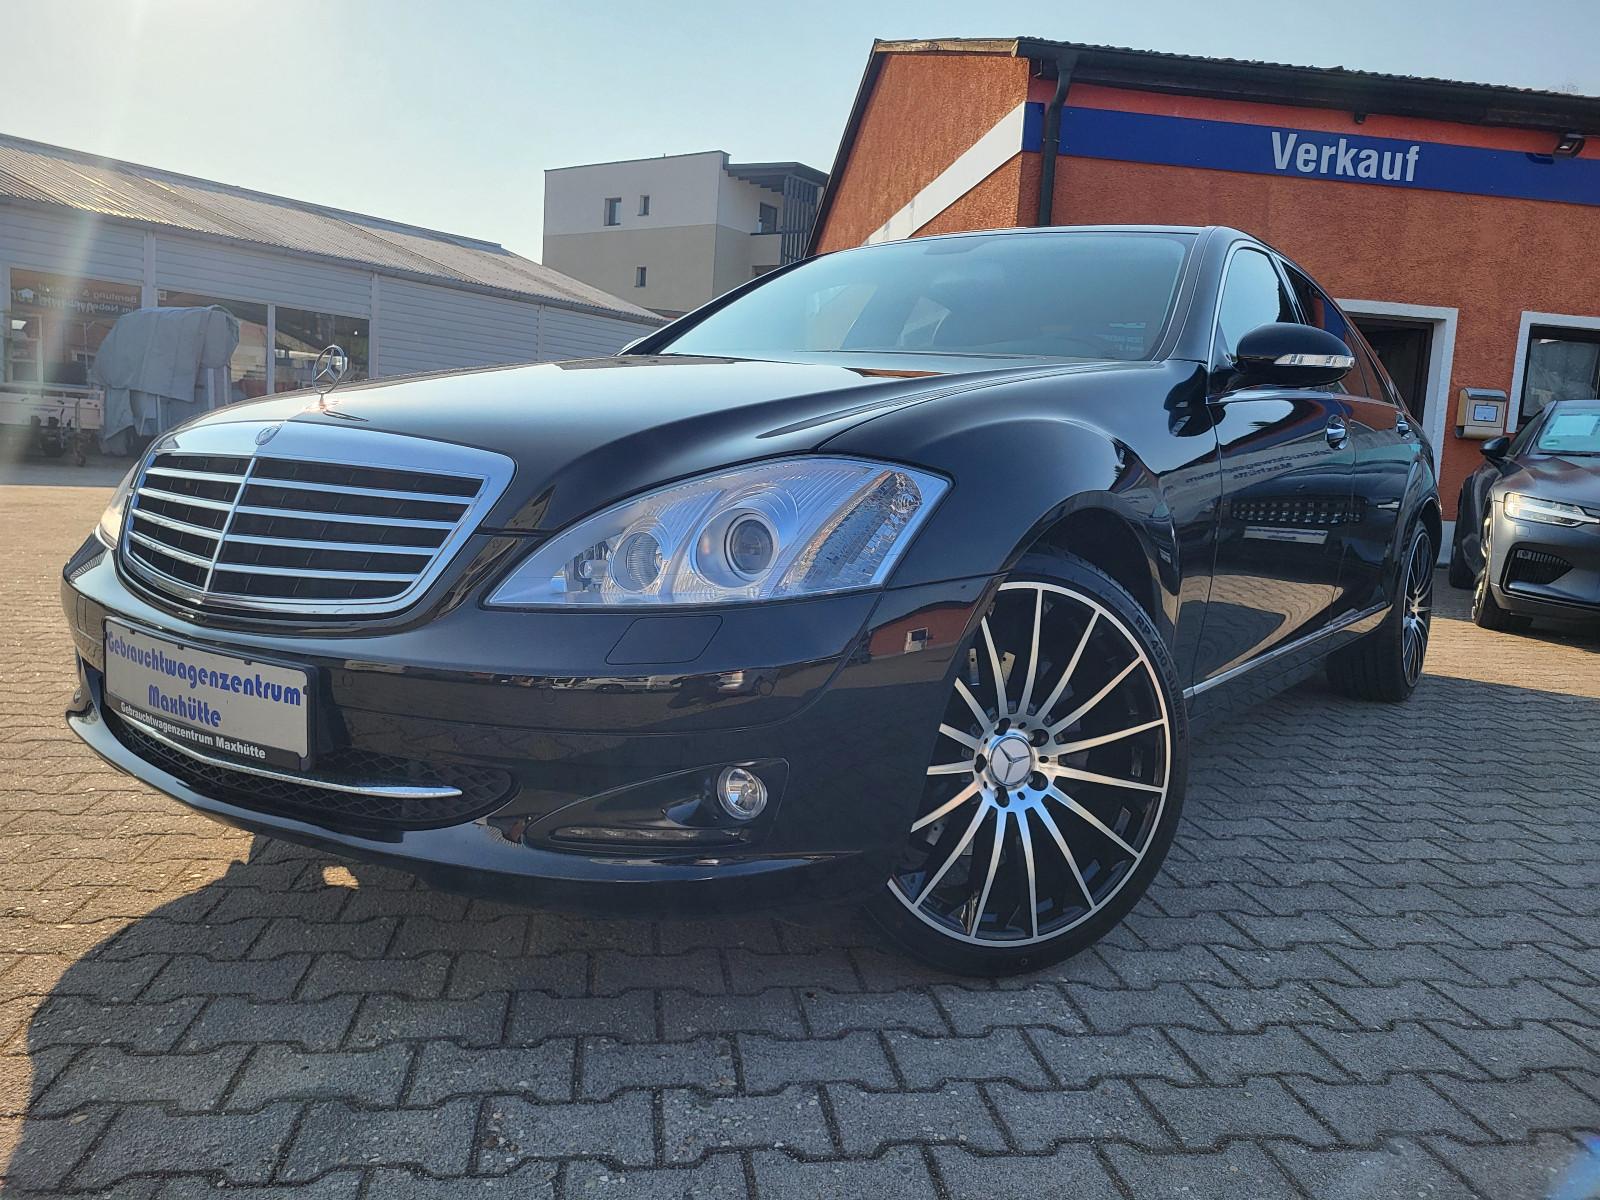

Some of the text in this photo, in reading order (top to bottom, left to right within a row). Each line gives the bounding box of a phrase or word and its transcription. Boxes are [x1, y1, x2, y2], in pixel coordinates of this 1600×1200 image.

[1271, 132, 1420, 182] Verkauf
[107, 633, 301, 706] Gebrauchtwagenzentrum
[1135, 615, 1185, 741] RP 430 SUMMER
[120, 702, 266, 759] Gebrauchtwagenzentrum Maxhütte
[148, 684, 222, 728] Maxhütte
